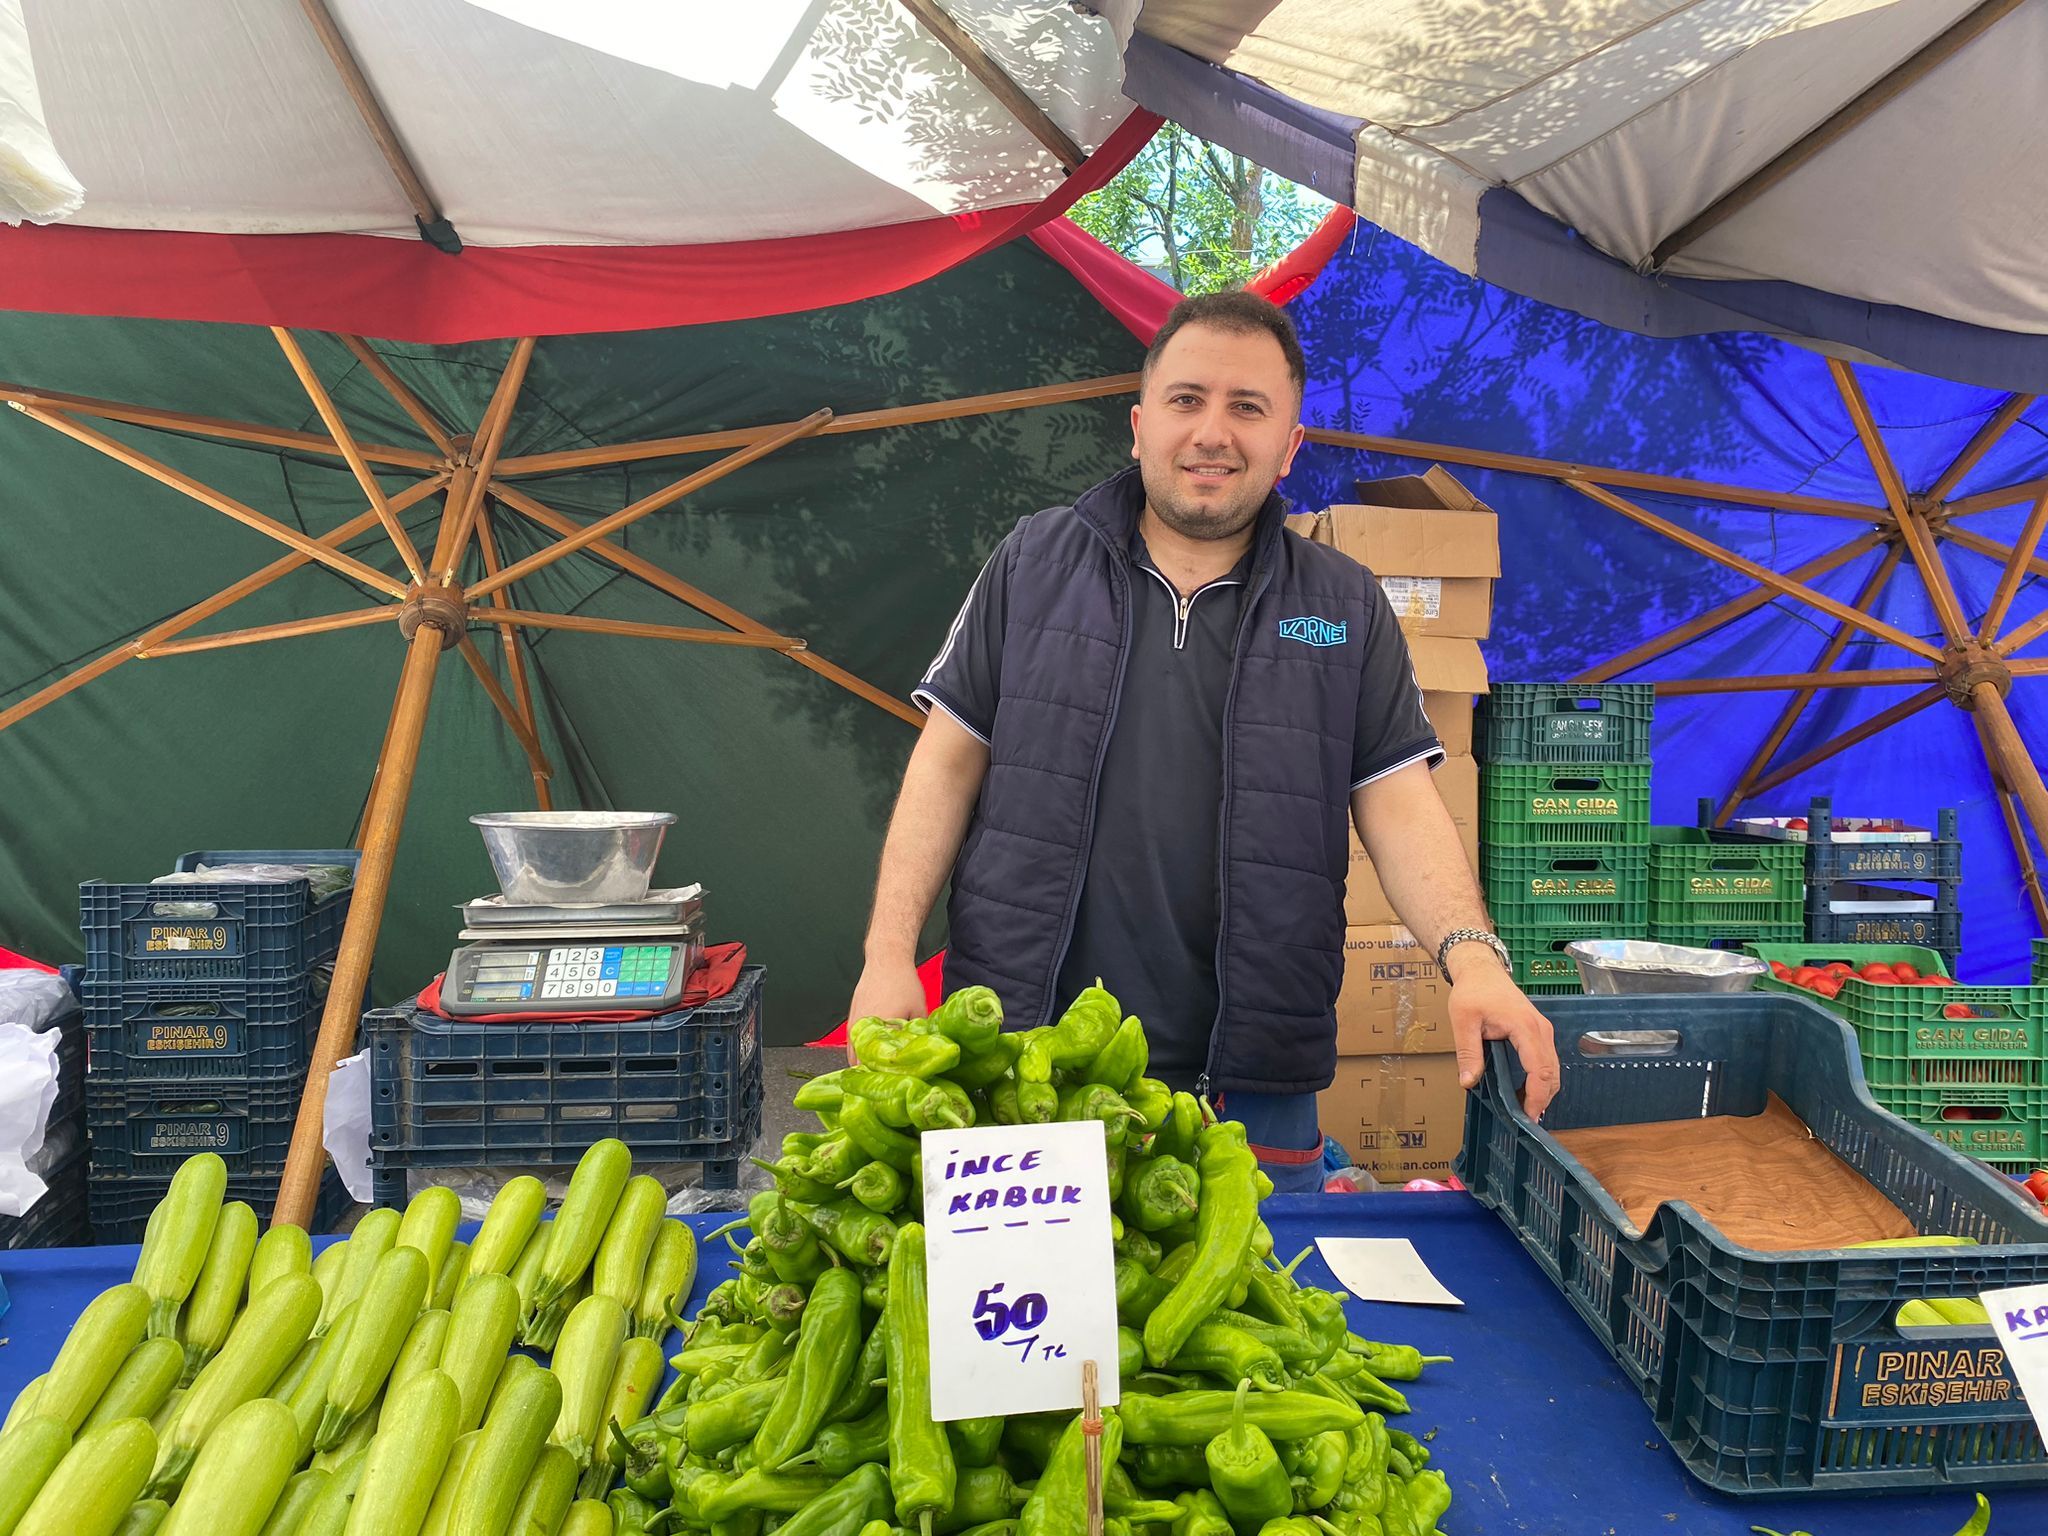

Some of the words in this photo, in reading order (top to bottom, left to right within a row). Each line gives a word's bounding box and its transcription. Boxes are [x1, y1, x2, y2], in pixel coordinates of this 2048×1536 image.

[1282, 619, 1343, 643] VORNE
[1532, 798, 1570, 809] CAN
[1576, 798, 1618, 809] GIDA
[1857, 853, 1901, 862] PINAR
[1913, 852, 1926, 870] 9
[1531, 879, 1568, 889] CAN
[1575, 879, 1616, 889] GIDA
[1691, 878, 1727, 888] CAN
[1733, 878, 1773, 888] GIDA
[151, 927, 208, 939] PINAR
[213, 926, 227, 950] 9
[1913, 922, 1926, 940] 9
[555, 952, 561, 961] 1
[572, 951, 581, 961] 2
[590, 951, 599, 960] 3
[550, 968, 559, 977] 4
[569, 967, 578, 977] 5
[587, 967, 596, 976] 6
[605, 967, 615, 975] C
[1531, 960, 1568, 970] CAN
[548, 985, 556, 994] 7
[566, 984, 575, 994] 8
[585, 983, 594, 993] 9
[603, 983, 611, 993] 0
[152, 1026, 209, 1039] PINAR
[214, 1025, 227, 1049] 9
[1916, 1028, 1965, 1041] CAN
[1974, 1028, 2028, 1041] GIDA
[156, 1123, 211, 1136] PINAR
[216, 1123, 229, 1147] 9
[1933, 1130, 1962, 1142] AN
[1972, 1130, 2026, 1143] GIDA
[948, 1185, 1082, 1215] KABUK
[972, 1282, 1048, 1341] 50
[1877, 1349, 2004, 1381] PINAR
